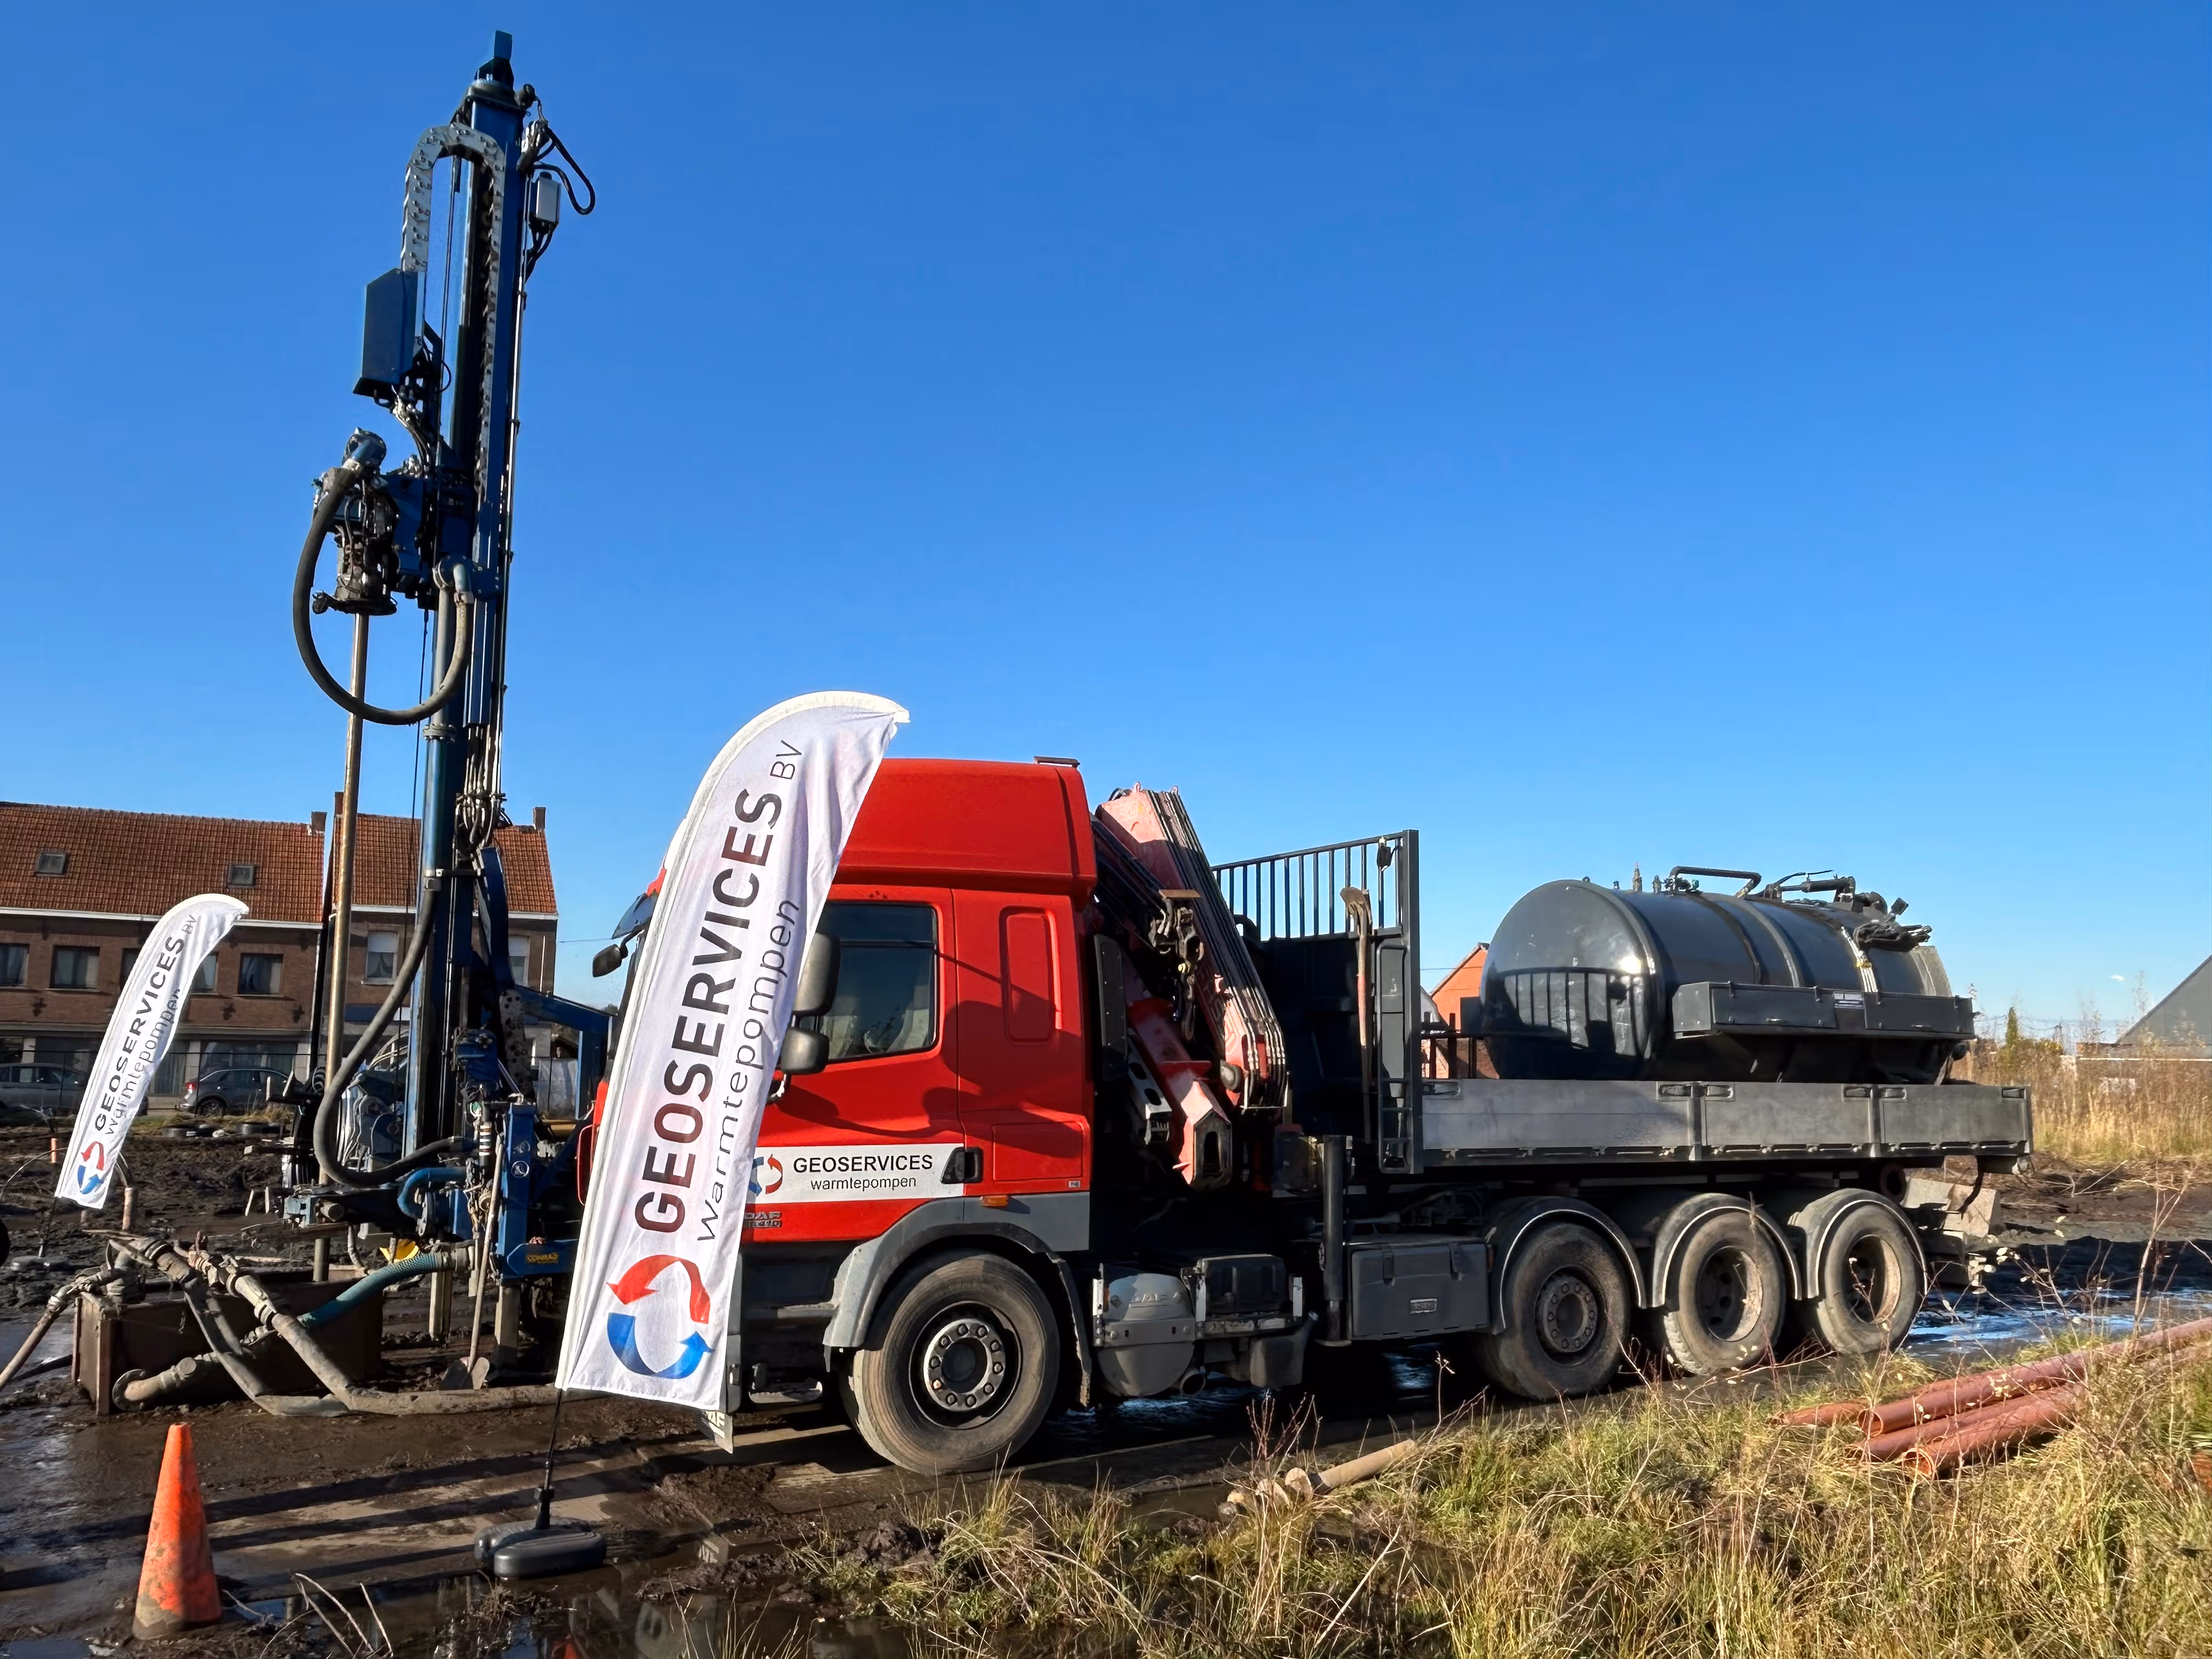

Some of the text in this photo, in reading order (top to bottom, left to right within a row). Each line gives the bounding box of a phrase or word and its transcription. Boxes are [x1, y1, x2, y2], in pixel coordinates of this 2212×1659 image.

[95, 935, 185, 1131] GEOSERVICES
[635, 788, 782, 1234] GEOSERVICES
[769, 739, 802, 780] BV
[793, 1154, 933, 1173] GEOSERVICES
[810, 1177, 917, 1192] warmtepompen
